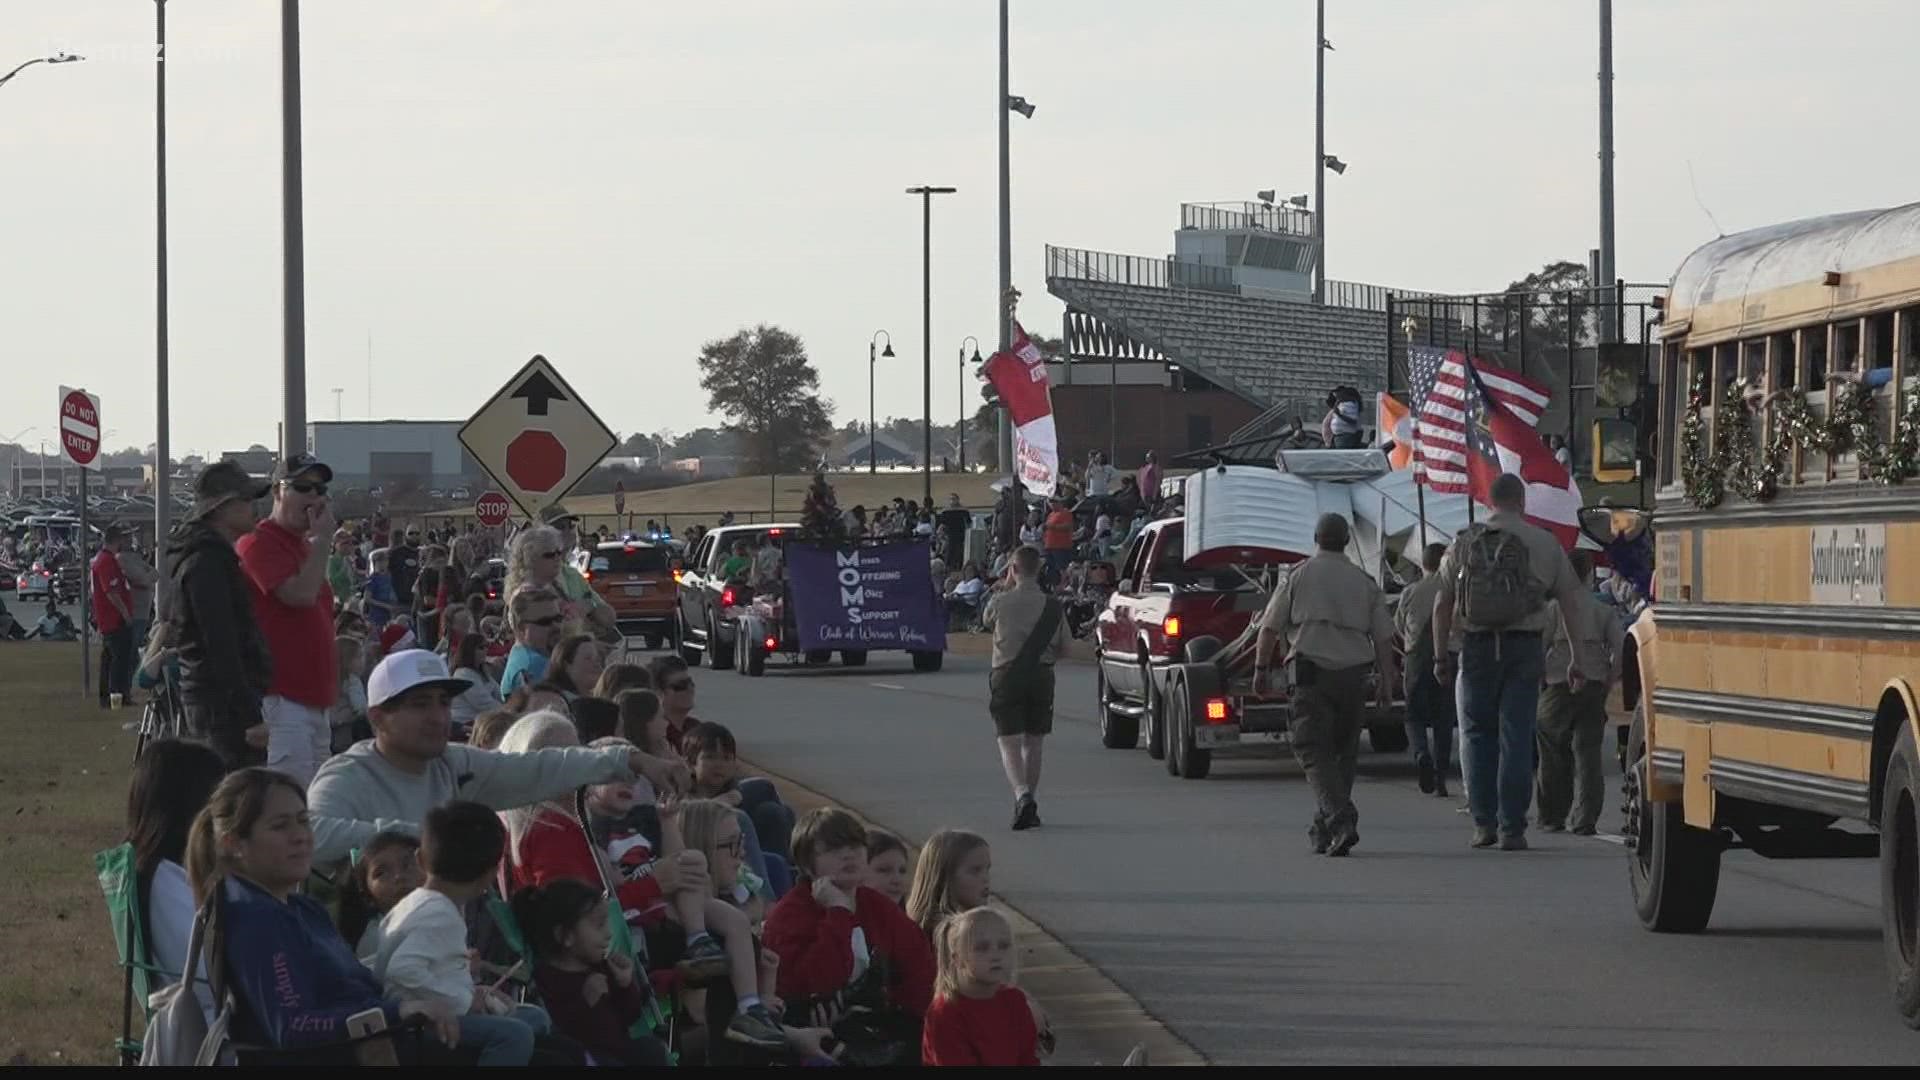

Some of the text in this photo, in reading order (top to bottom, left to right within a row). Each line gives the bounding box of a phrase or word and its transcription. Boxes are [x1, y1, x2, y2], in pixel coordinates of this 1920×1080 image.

[65, 402, 95, 422] DO NOT
[68, 434, 92, 453] ENTER
[478, 502, 508, 516] STOP
[819, 624, 842, 641] Club
[844, 625, 855, 641] of
